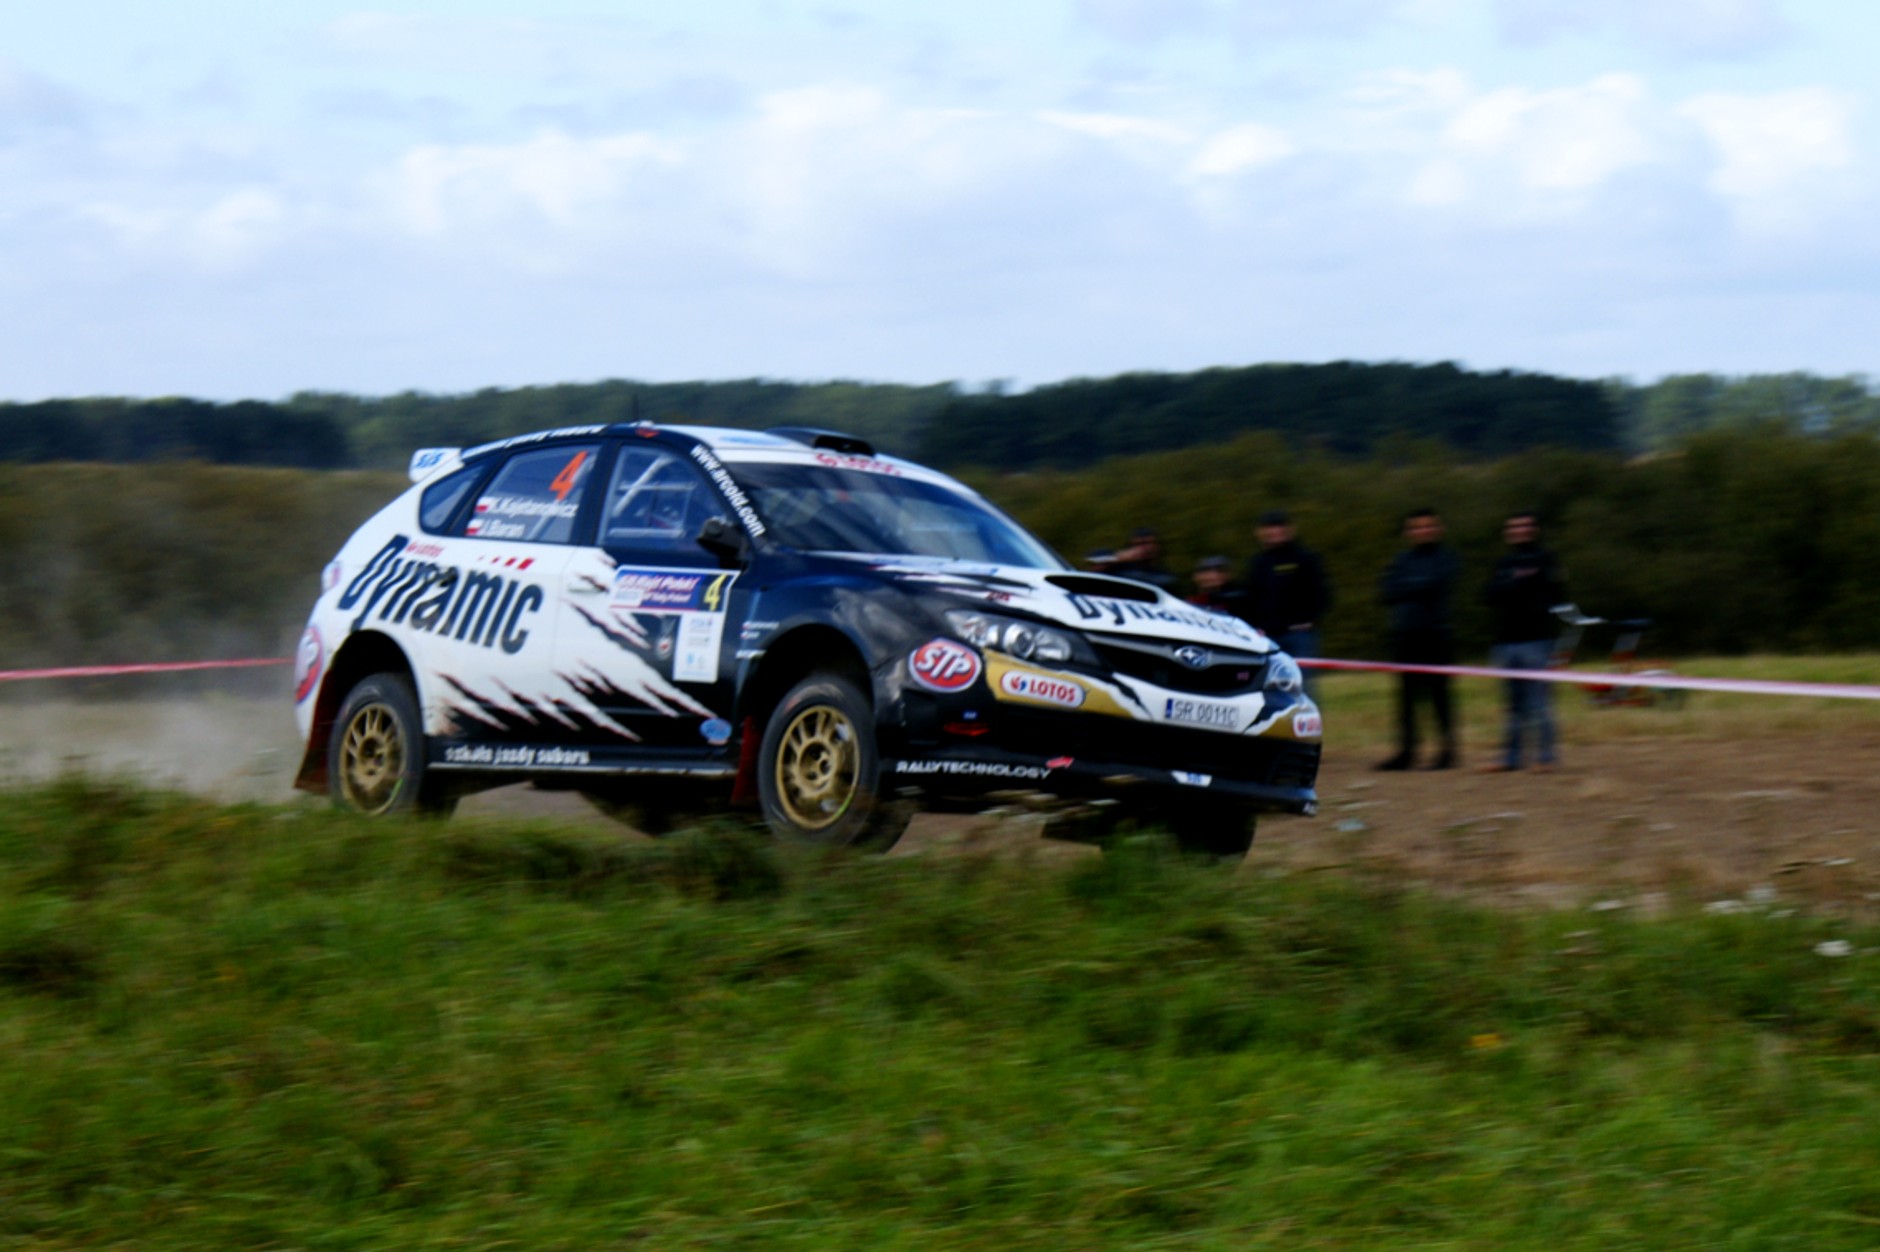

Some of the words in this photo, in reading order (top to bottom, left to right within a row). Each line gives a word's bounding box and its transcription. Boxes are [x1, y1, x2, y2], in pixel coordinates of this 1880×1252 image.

[549, 451, 589, 502] 4
[703, 572, 728, 612] 4
[916, 646, 972, 680] STP
[1029, 678, 1076, 703] LOTOS
[1174, 701, 1194, 721] SR
[895, 759, 1052, 779] RALLYTECHNOLOGY
